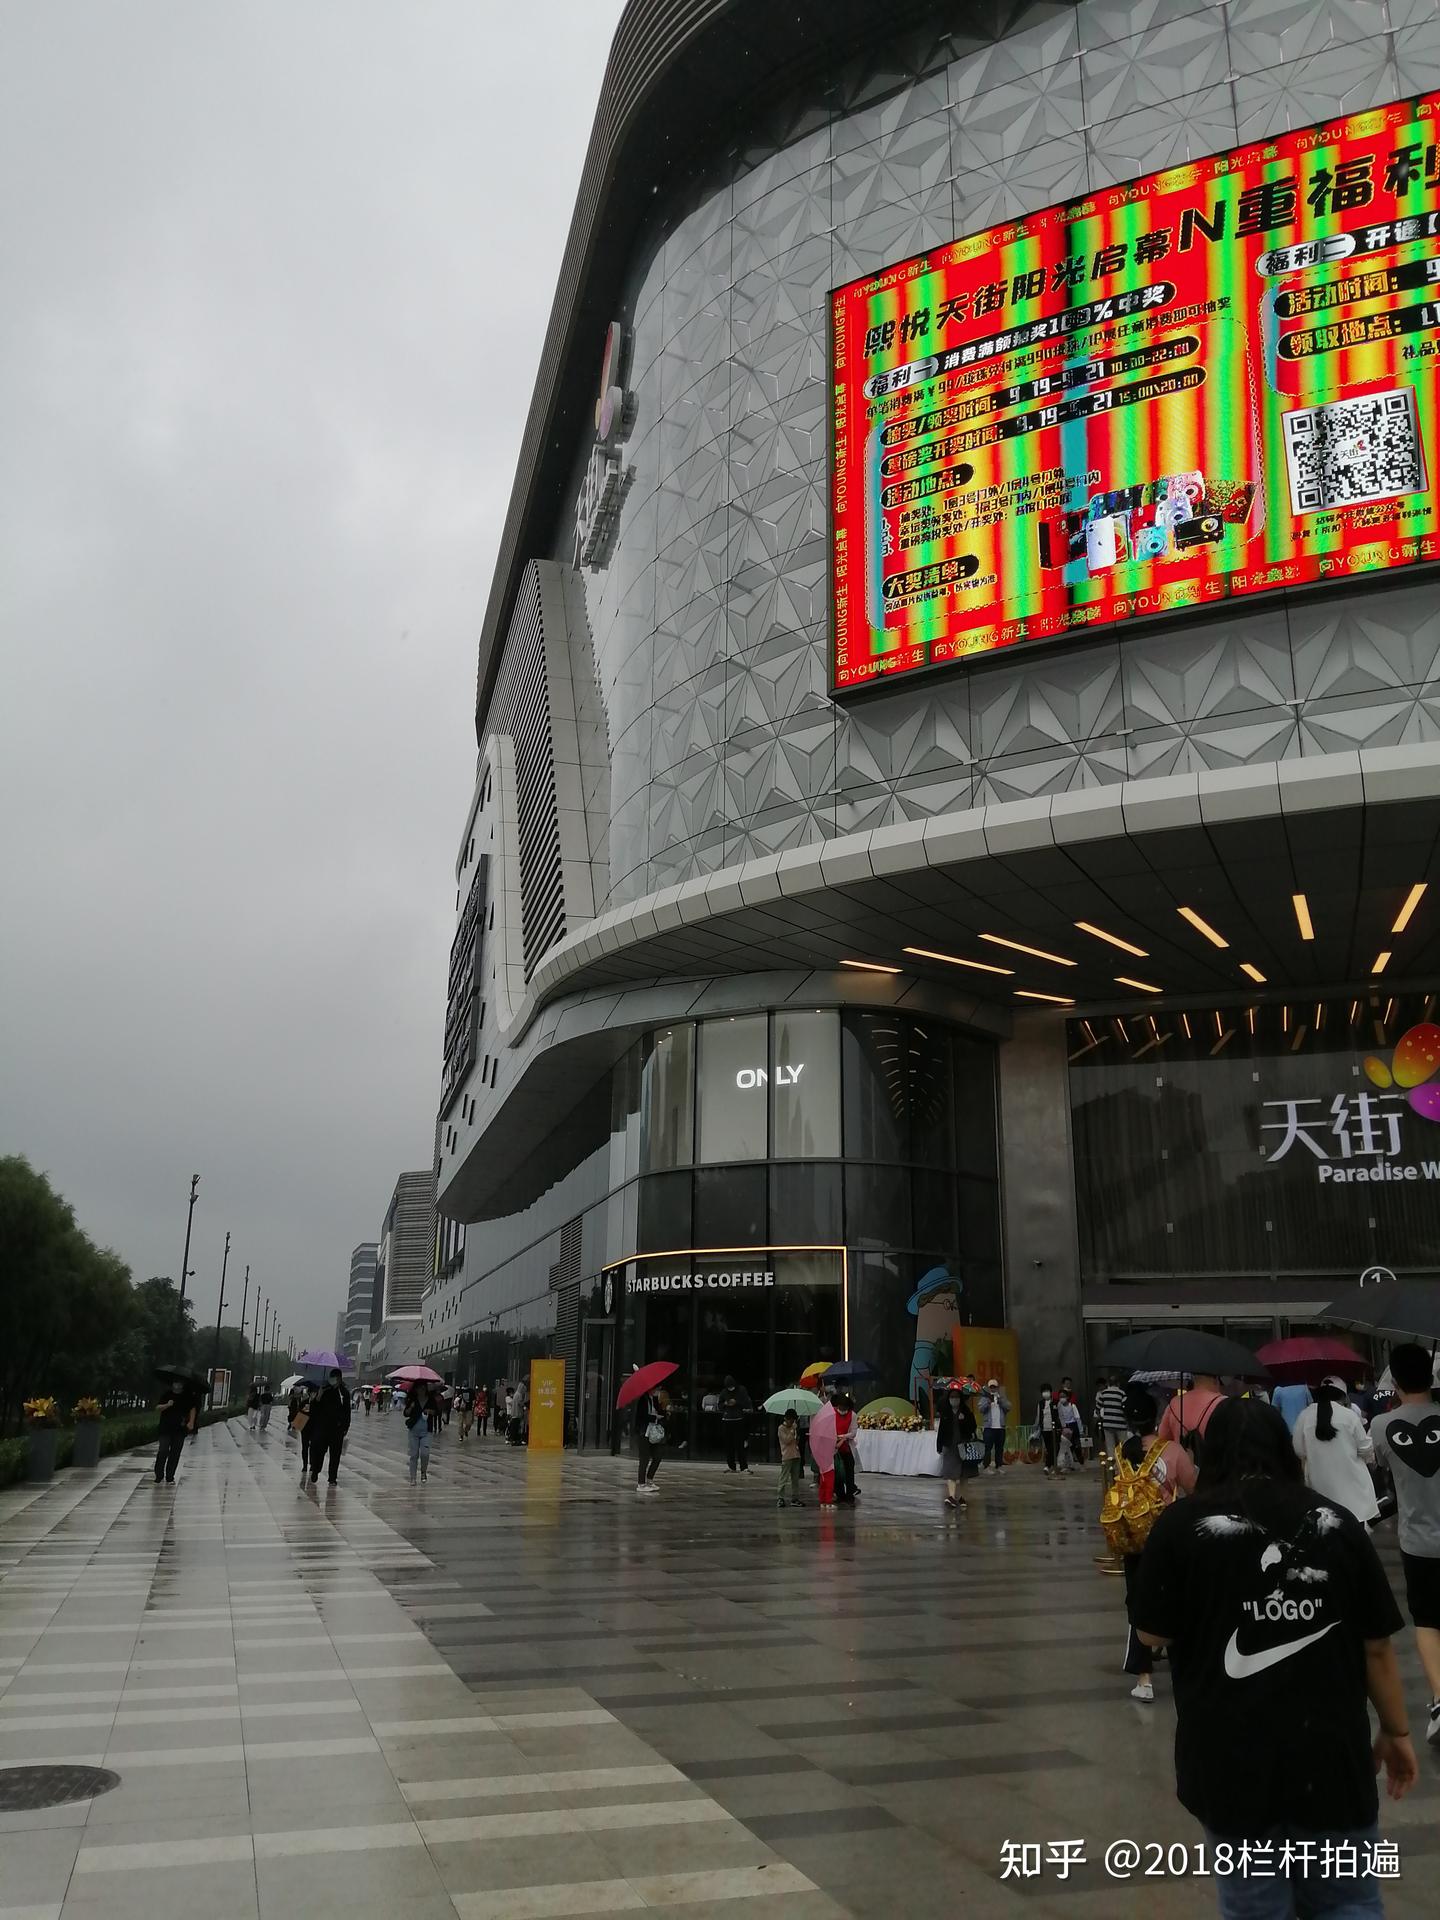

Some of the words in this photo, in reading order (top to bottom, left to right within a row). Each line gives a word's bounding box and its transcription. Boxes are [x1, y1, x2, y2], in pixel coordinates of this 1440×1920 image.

[1265, 236, 1347, 275] 福利二
[870, 363, 933, 397] 福利一
[736, 1063, 804, 1089] ONLY
[1260, 1092, 1403, 1161] 天街
[1318, 1161, 1417, 1183] Paradise
[627, 1274, 704, 1293] STARBUCKS
[708, 1271, 774, 1288] COFFEE
[1242, 1598, 1323, 1621] "LOGO"
